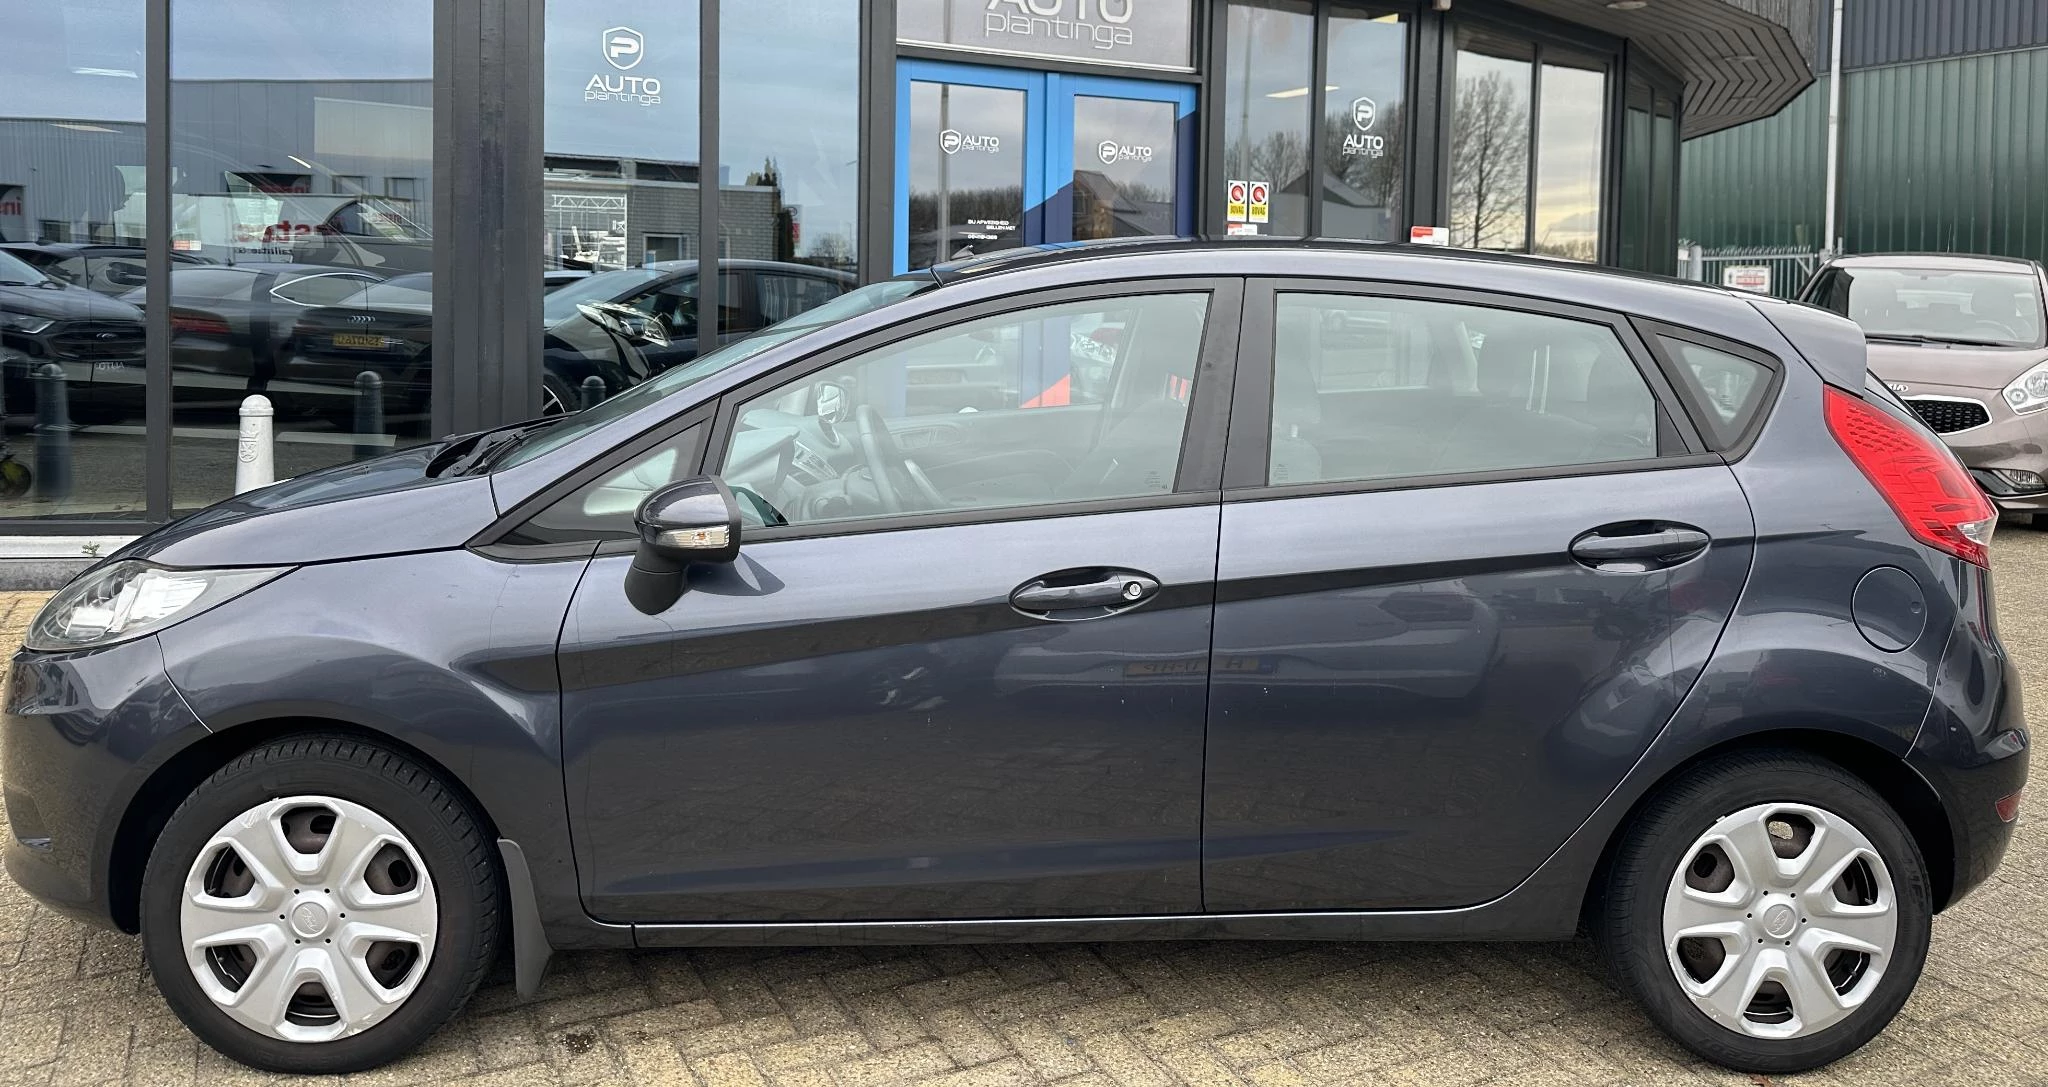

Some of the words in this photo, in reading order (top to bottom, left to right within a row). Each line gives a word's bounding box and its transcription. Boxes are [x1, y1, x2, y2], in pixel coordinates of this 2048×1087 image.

[986, 10, 1133, 49] plantinga
[585, 73, 661, 95] AUTO
[584, 90, 661, 106] plantinga
[962, 135, 1000, 147] AUTO
[1343, 133, 1384, 150] AUTO
[1118, 145, 1152, 157] AUTO
[1887, 383, 1909, 392] KIA
